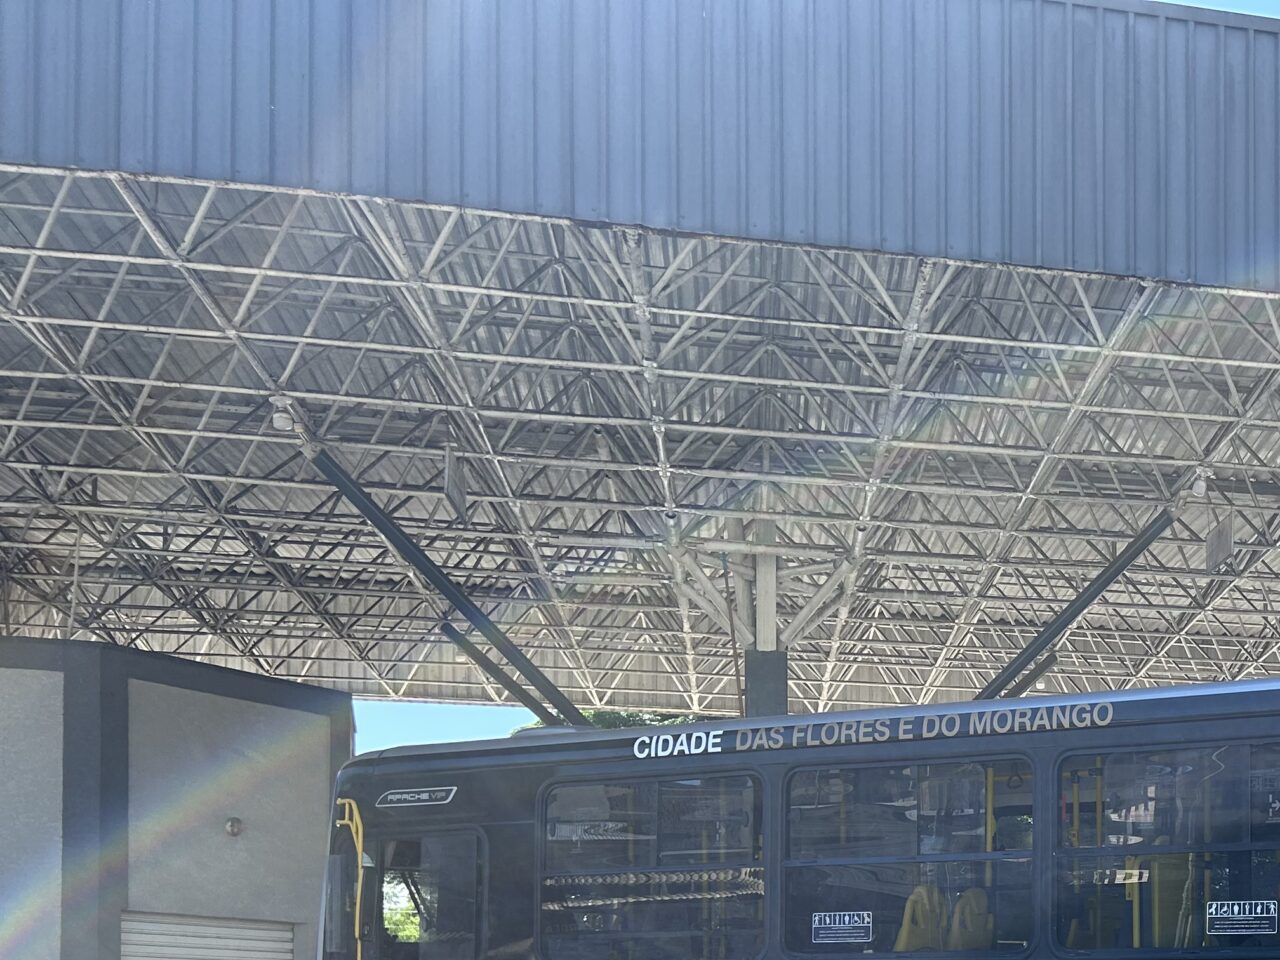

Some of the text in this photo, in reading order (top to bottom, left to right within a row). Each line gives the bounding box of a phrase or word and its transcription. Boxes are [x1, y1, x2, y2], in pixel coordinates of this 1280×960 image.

[633, 702, 1114, 759] CIDADE DAS FLORES E DO MORANGO
[388, 792, 429, 801] APACHE
